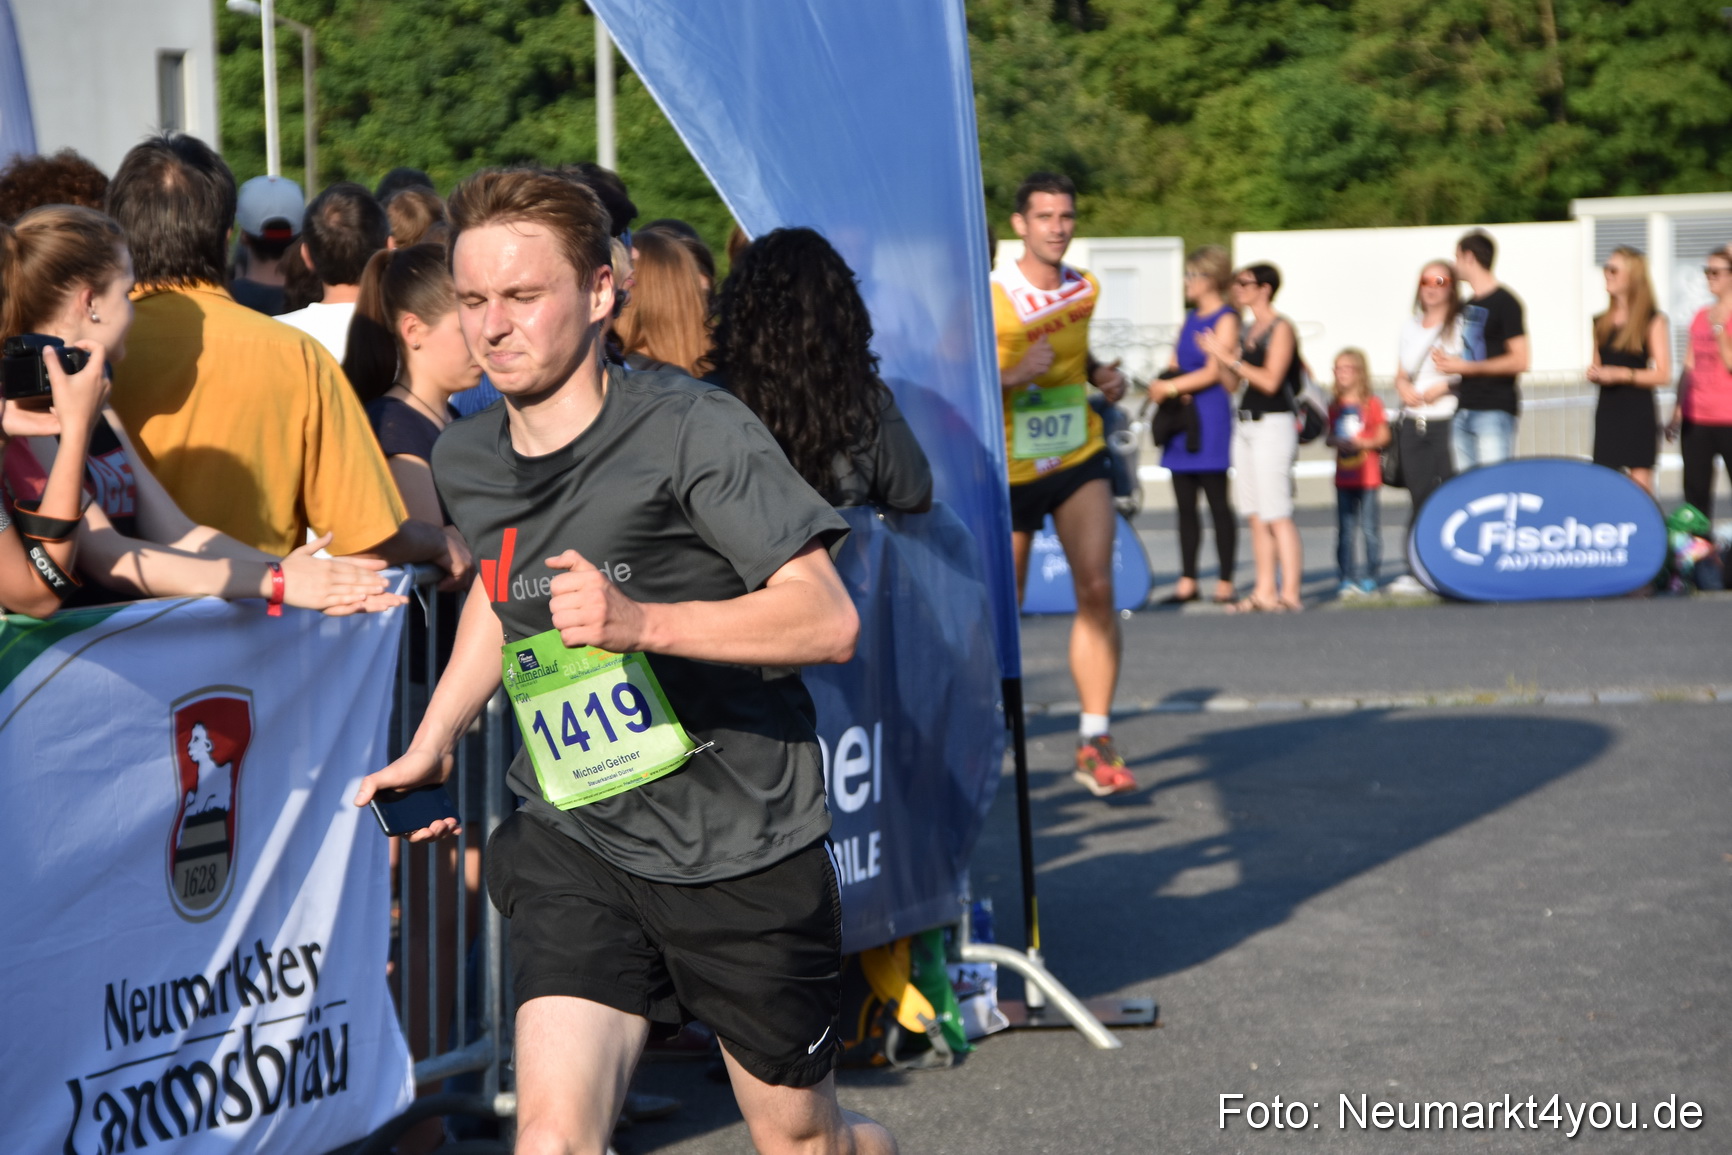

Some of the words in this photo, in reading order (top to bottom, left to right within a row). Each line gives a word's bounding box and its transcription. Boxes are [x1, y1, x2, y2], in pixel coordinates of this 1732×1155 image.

[1027, 413, 1074, 439] 907
[1478, 516, 1637, 556] Fischer
[29, 546, 65, 588] SONY
[1495, 549, 1628, 572] AUTOMOBILE
[562, 658, 590, 677] 2015
[532, 681, 653, 762] 1419
[572, 761, 606, 780] Michael
[605, 750, 641, 770] Geitner
[183, 862, 217, 898] 1628
